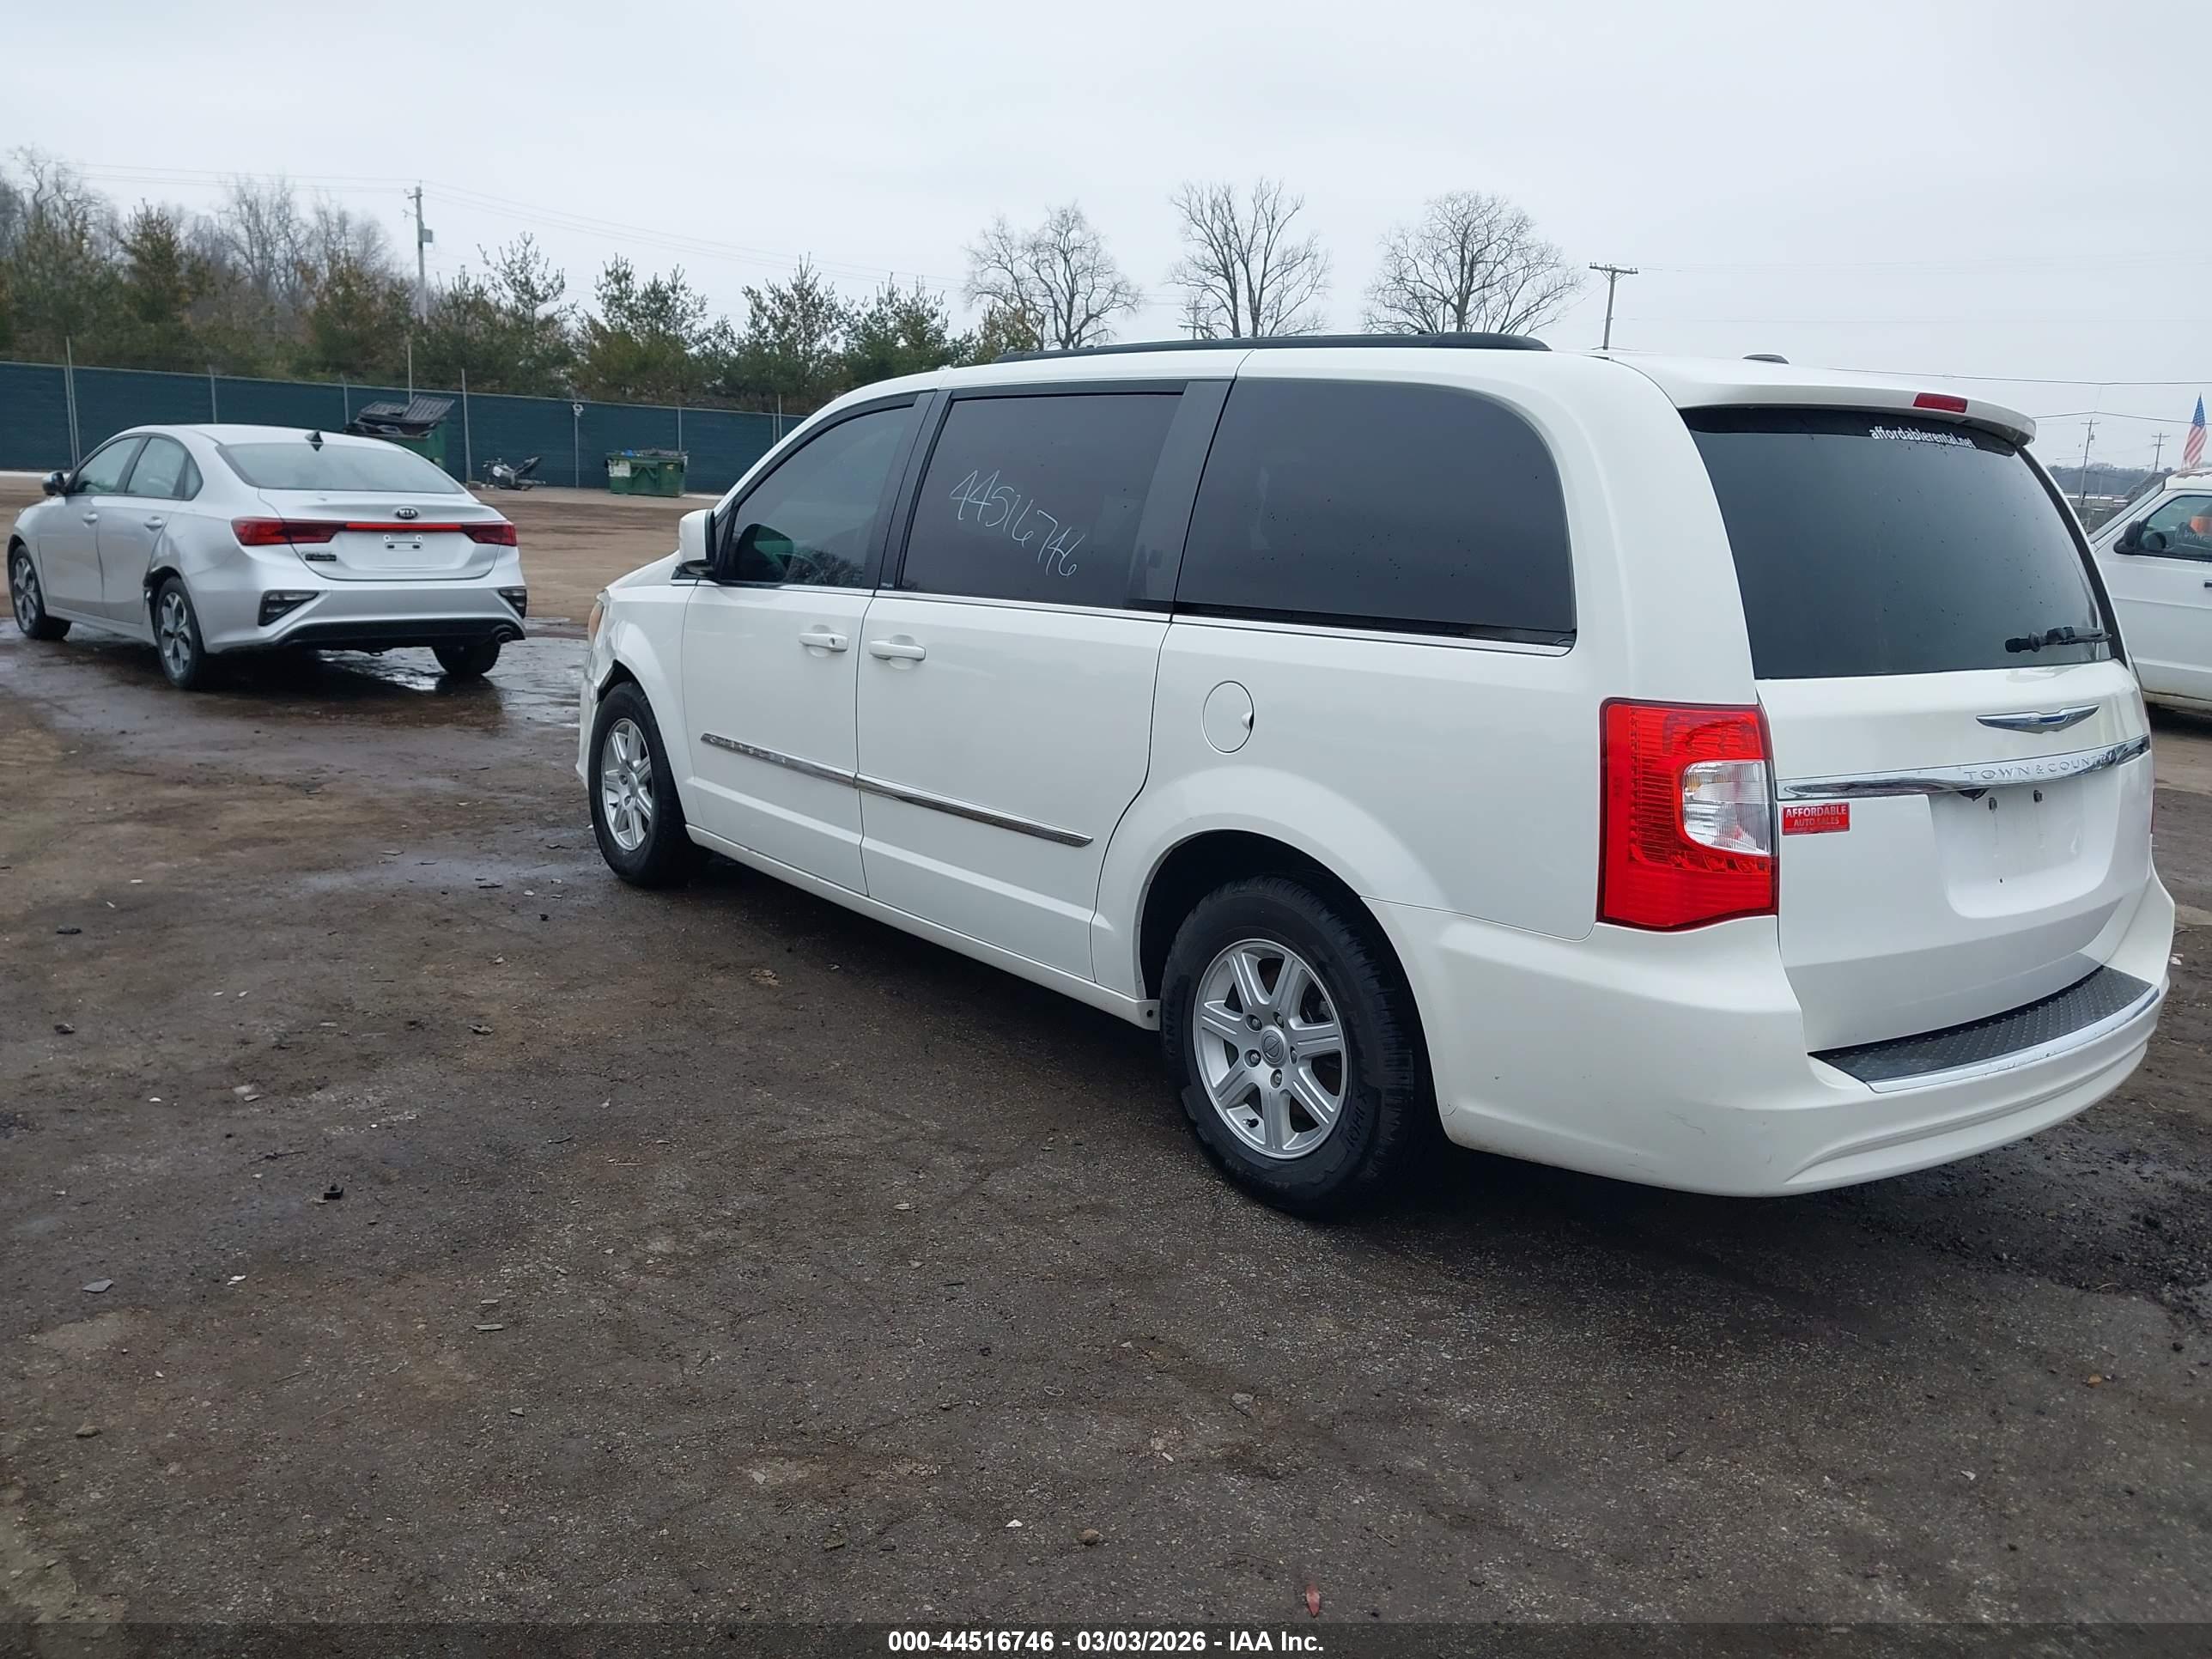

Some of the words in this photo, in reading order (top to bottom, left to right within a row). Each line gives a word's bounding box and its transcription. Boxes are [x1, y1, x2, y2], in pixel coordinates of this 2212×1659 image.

[1869, 426, 1976, 448] affordablerental.net
[949, 470, 1085, 577] 44516746
[1785, 805, 1847, 818] AFFORDABLE
[1794, 817, 1815, 827] AUTO
